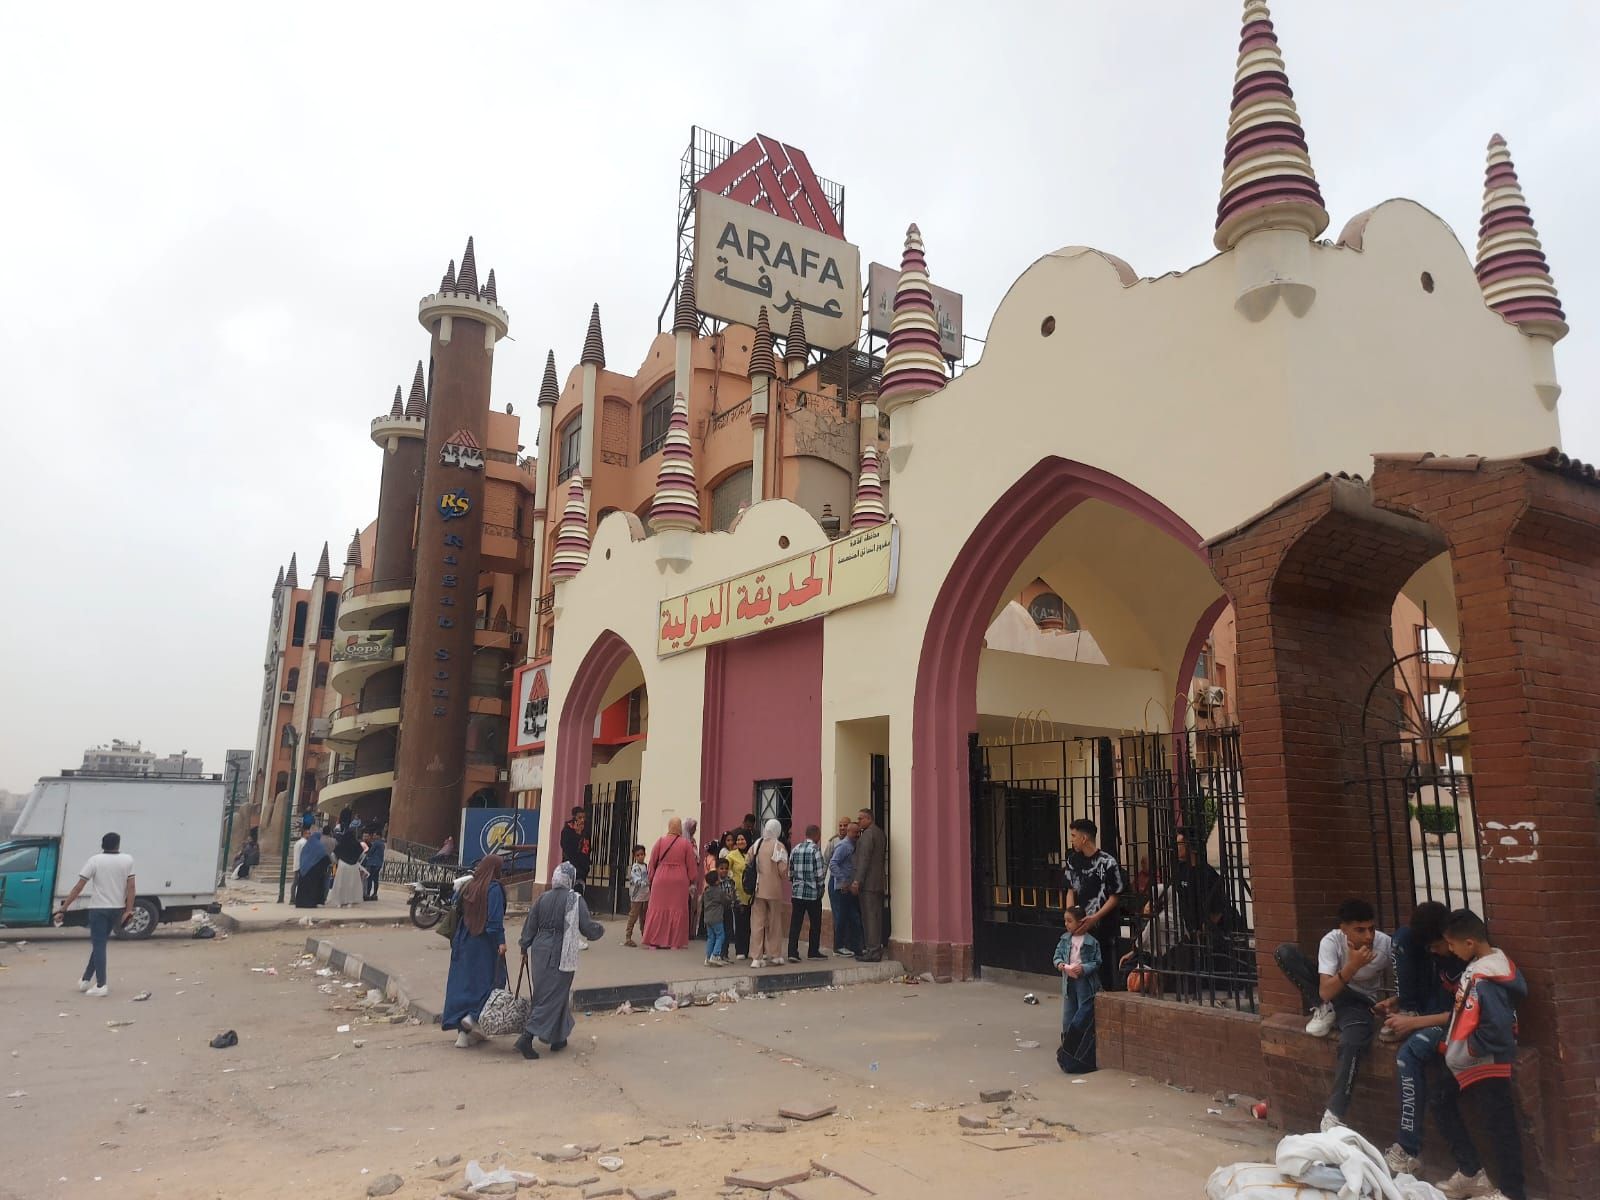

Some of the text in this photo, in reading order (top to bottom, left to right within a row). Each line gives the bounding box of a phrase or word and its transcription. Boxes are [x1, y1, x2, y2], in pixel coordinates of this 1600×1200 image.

[716, 221, 844, 290] ARAFA
[714, 255, 843, 319] عرفة
[441, 443, 484, 461] ARAFA
[441, 493, 469, 513] RS
[661, 544, 834, 649] الحديقة الدولية
[1401, 1075, 1416, 1132] MONCLER
